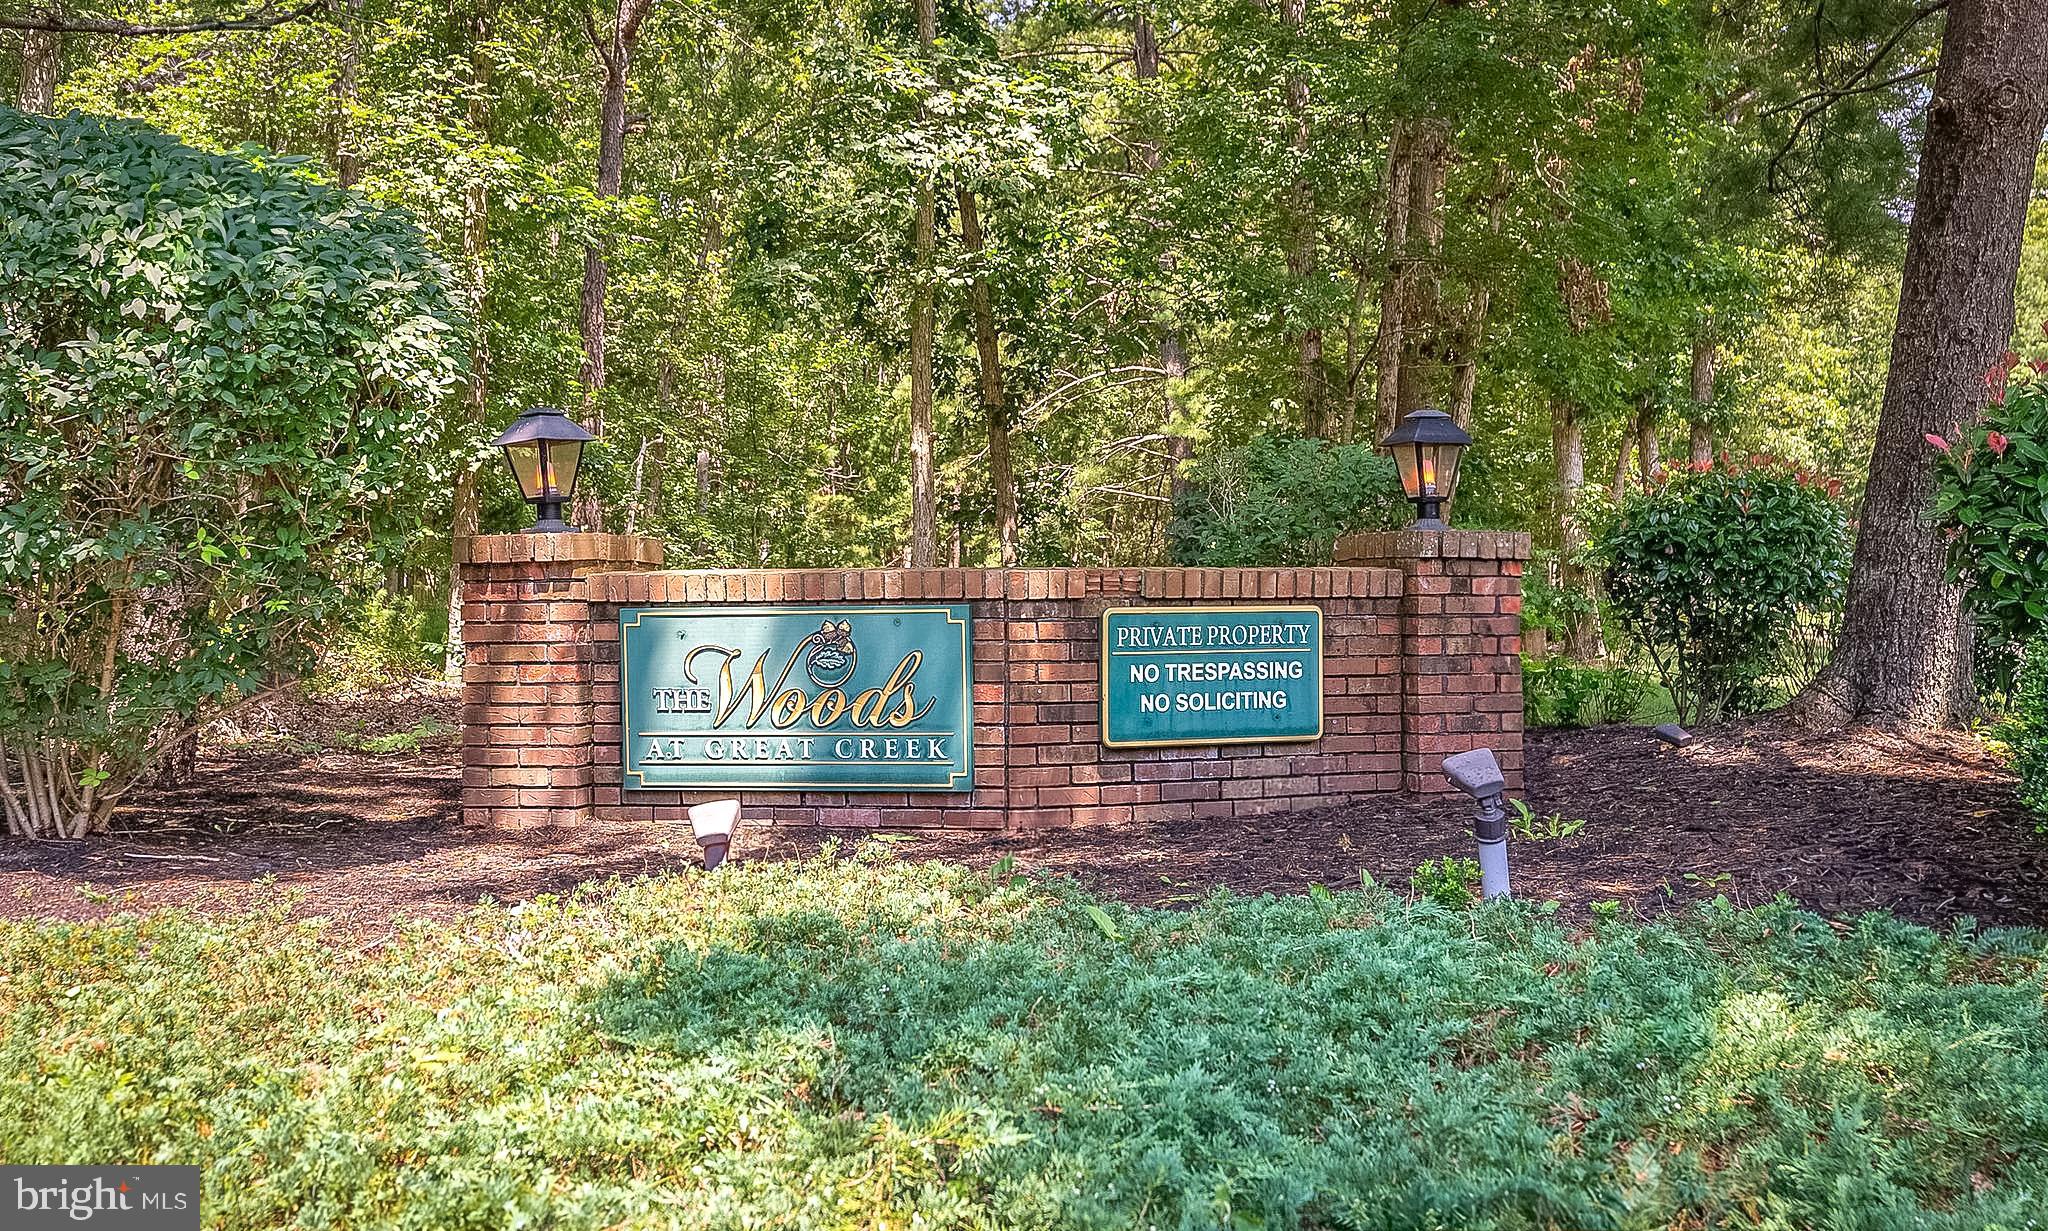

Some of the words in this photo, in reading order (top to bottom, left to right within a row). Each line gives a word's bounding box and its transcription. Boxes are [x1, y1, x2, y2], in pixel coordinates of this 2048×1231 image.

[1116, 625, 1203, 648] PRIVATE
[1206, 624, 1312, 646] PROPERTY
[652, 687, 713, 713] THE
[683, 631, 937, 730] Woods
[1130, 663, 1160, 683] NO
[1165, 660, 1303, 682] TRESPASSING
[1140, 693, 1170, 713] NO
[1175, 690, 1287, 712] SOLICITING
[645, 738, 685, 761] AT
[704, 738, 815, 761] GREAT
[835, 738, 949, 760] CREEK
